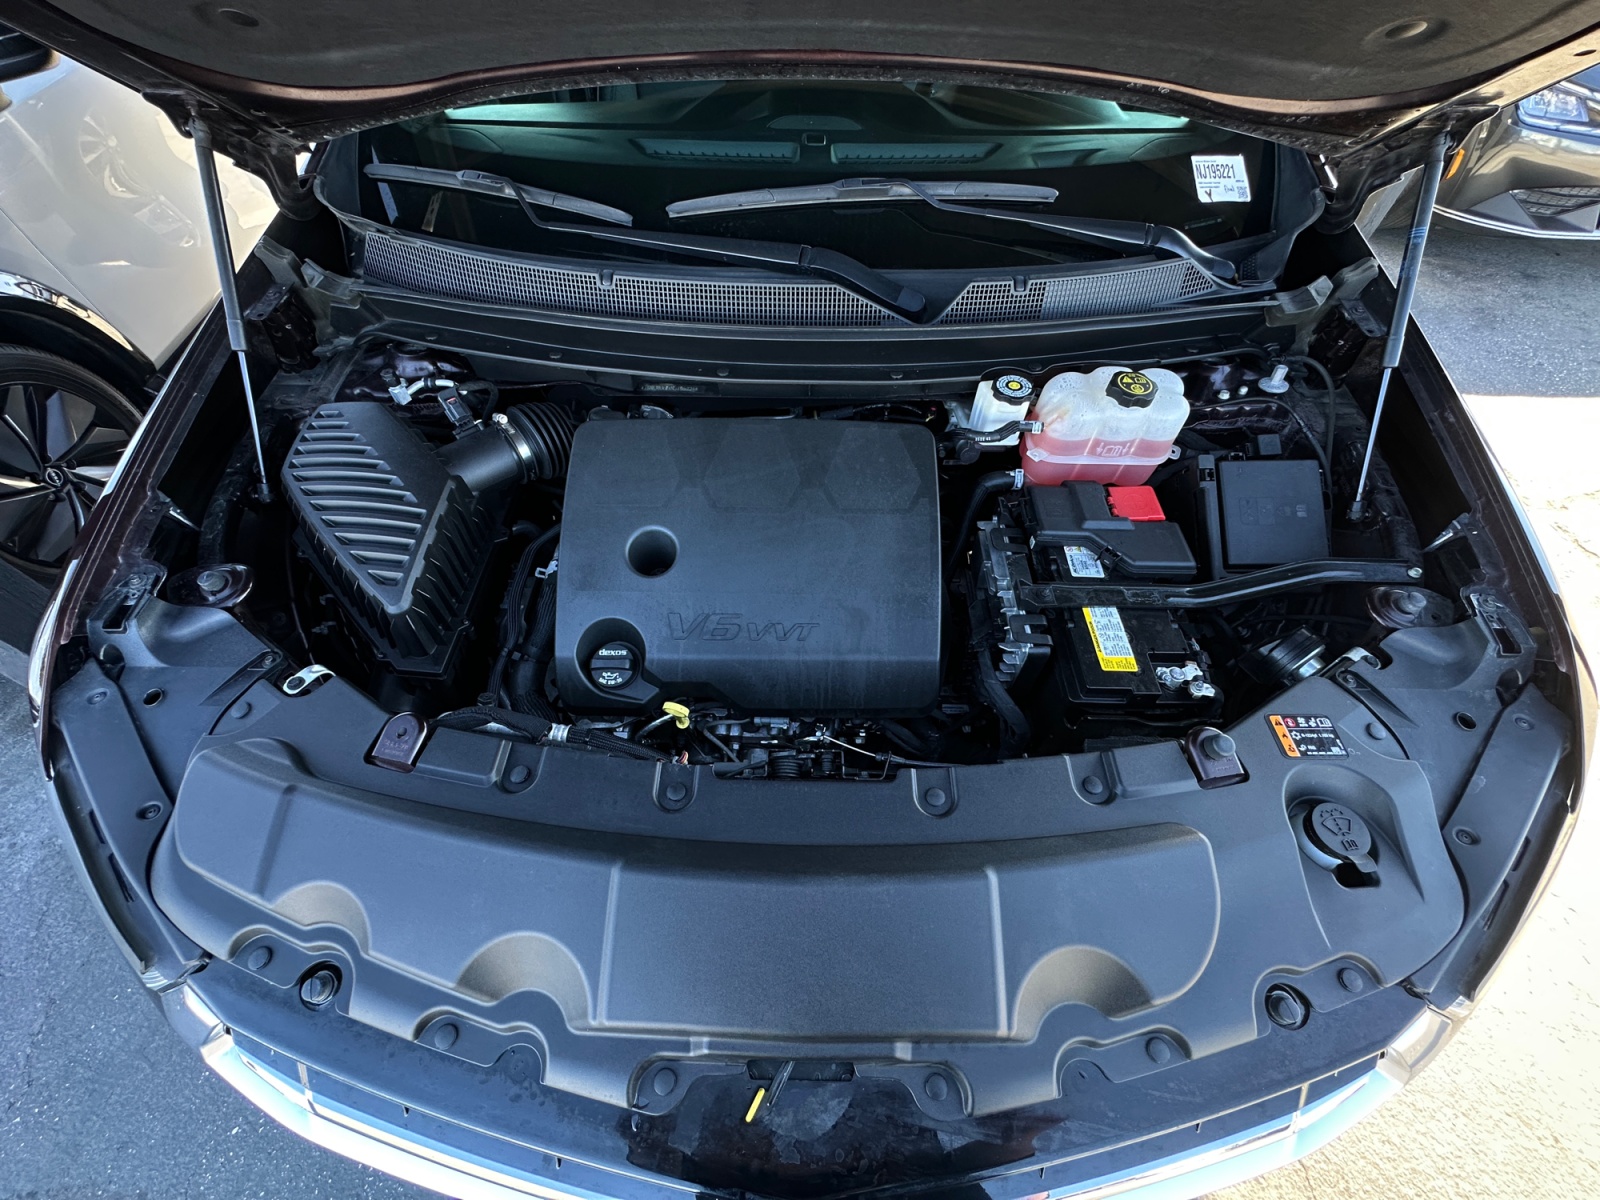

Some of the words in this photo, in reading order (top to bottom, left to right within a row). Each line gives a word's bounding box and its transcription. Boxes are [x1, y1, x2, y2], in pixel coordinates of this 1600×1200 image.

[1195, 163, 1236, 179] NJ195221
[668, 612, 743, 641] V6
[747, 622, 820, 641] VVT
[598, 648, 627, 656] dexos
